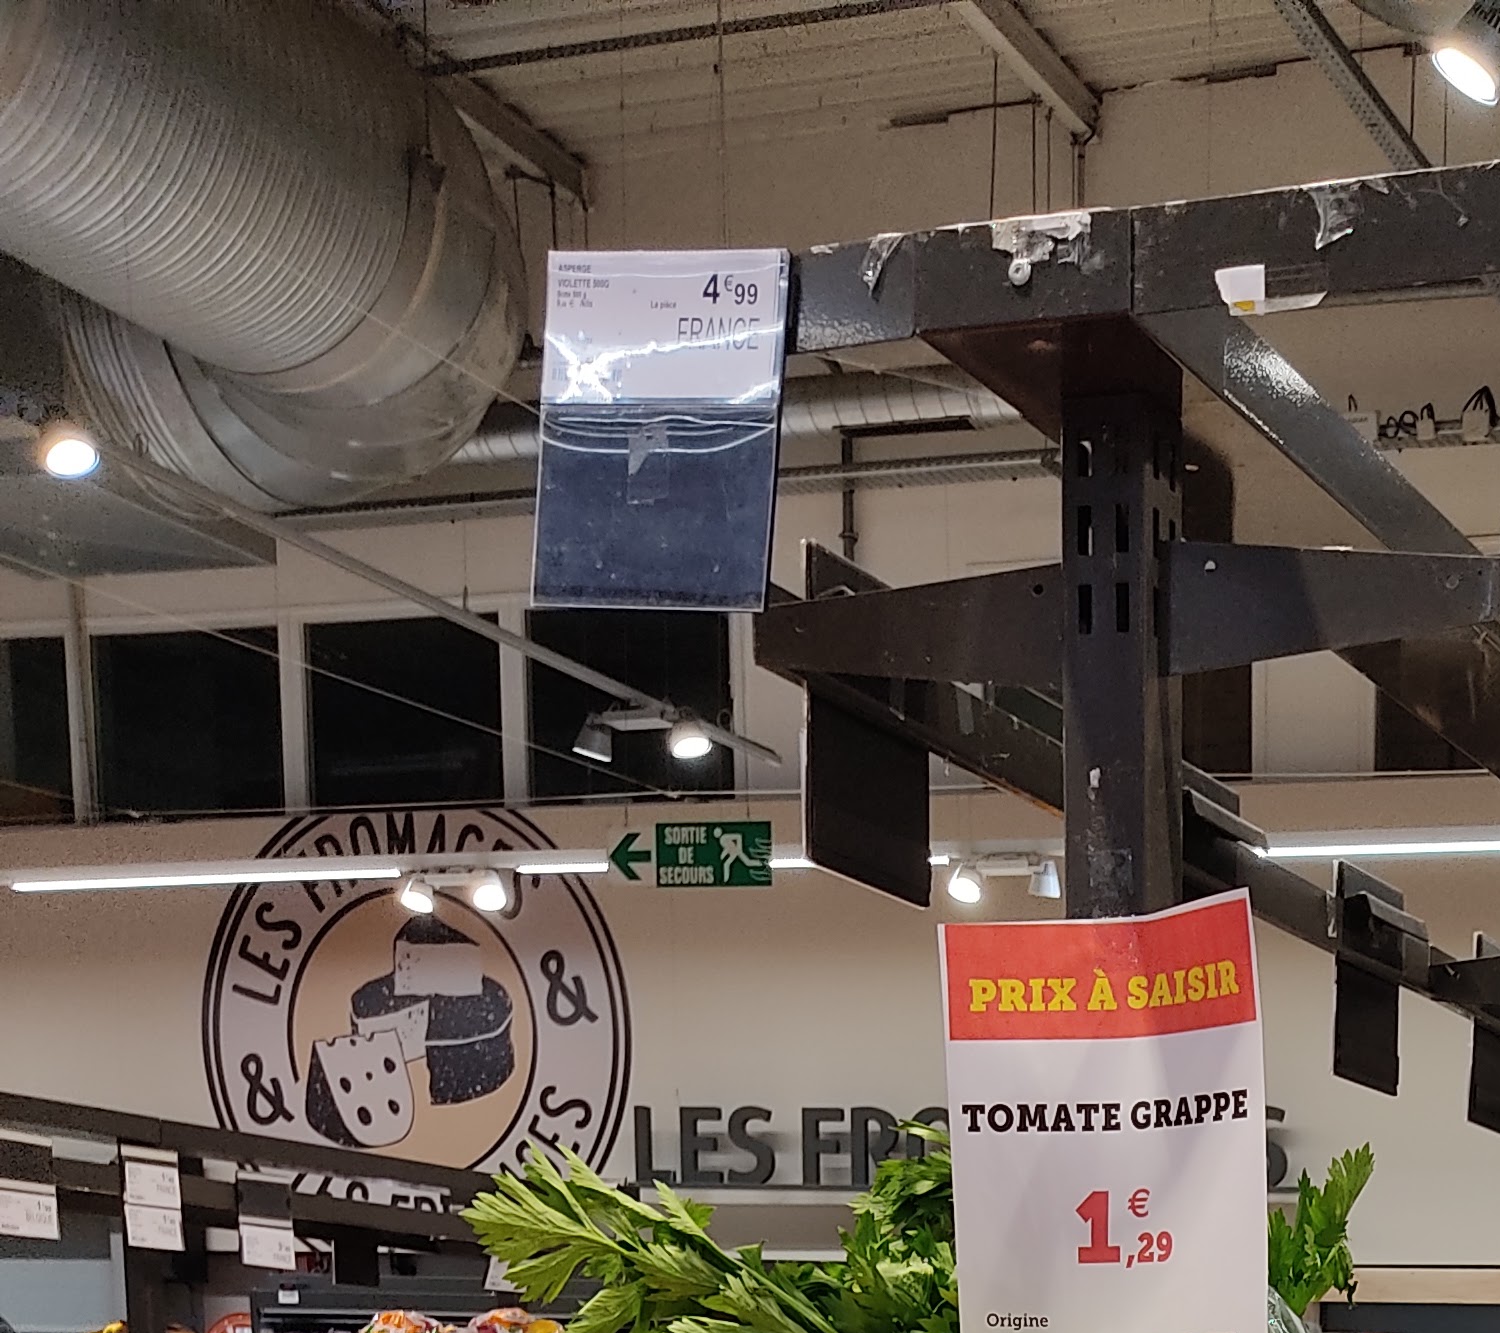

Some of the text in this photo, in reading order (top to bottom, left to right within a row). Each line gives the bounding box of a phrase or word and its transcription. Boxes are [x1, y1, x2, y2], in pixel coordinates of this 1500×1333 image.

[677, 317, 760, 350] FRANCE
[664, 826, 707, 845] SORTIE
[678, 847, 694, 865] DE
[659, 865, 714, 884] SECOURS
[232, 902, 303, 1005] LES
[969, 959, 1240, 1012] PRIX À SAISIR
[962, 1088, 1249, 1133] TOMATE GRAPPE
[633, 1105, 776, 1185] LES
[986, 1313, 1049, 1331] Origine
